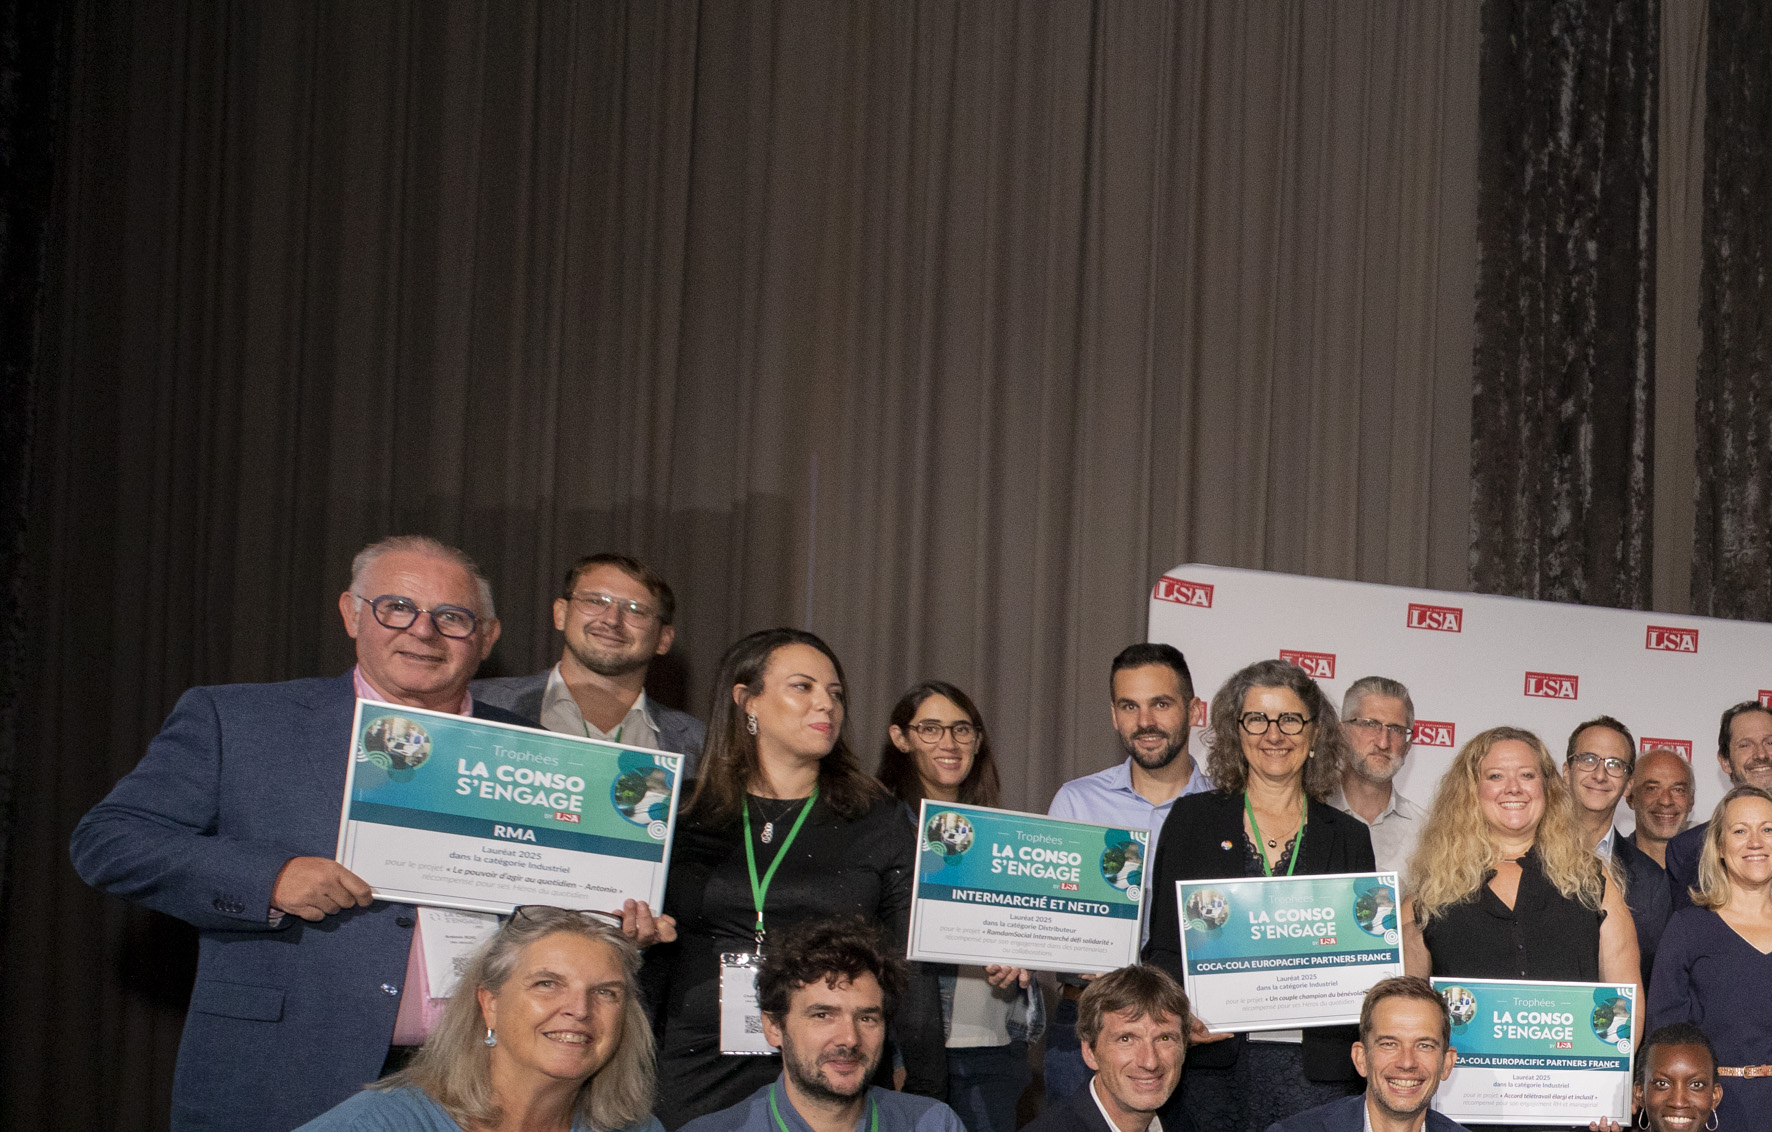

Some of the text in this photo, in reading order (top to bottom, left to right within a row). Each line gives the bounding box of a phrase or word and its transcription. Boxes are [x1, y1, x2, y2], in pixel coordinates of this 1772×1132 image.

[1158, 582, 1210, 607] LSA
[1410, 610, 1459, 631] LSA
[1648, 631, 1696, 652] LSA
[1527, 678, 1575, 698] LSA
[493, 745, 559, 766] Trophées
[458, 758, 585, 792] LA CONSO
[456, 777, 583, 812] S'ENGAGE
[493, 825, 537, 842] RMA
[992, 843, 1081, 866] LA CONSO
[991, 859, 1081, 882] S'ENGAGE
[952, 889, 1109, 915] INTERMARCHÉ ET NETTO
[1249, 907, 1335, 924] LA CONSO
[1250, 922, 1336, 940] S'ENGAGE
[1197, 953, 1391, 972] COCA-COLA EUROPACIFIC PARTNERS FRANCE
[1493, 1011, 1573, 1025] LA CONSO
[1493, 1025, 1573, 1040] S'ENGAGE
[1456, 1057, 1620, 1068] CA-COLA EUROPACIFIC PARTNERS FRANCE
